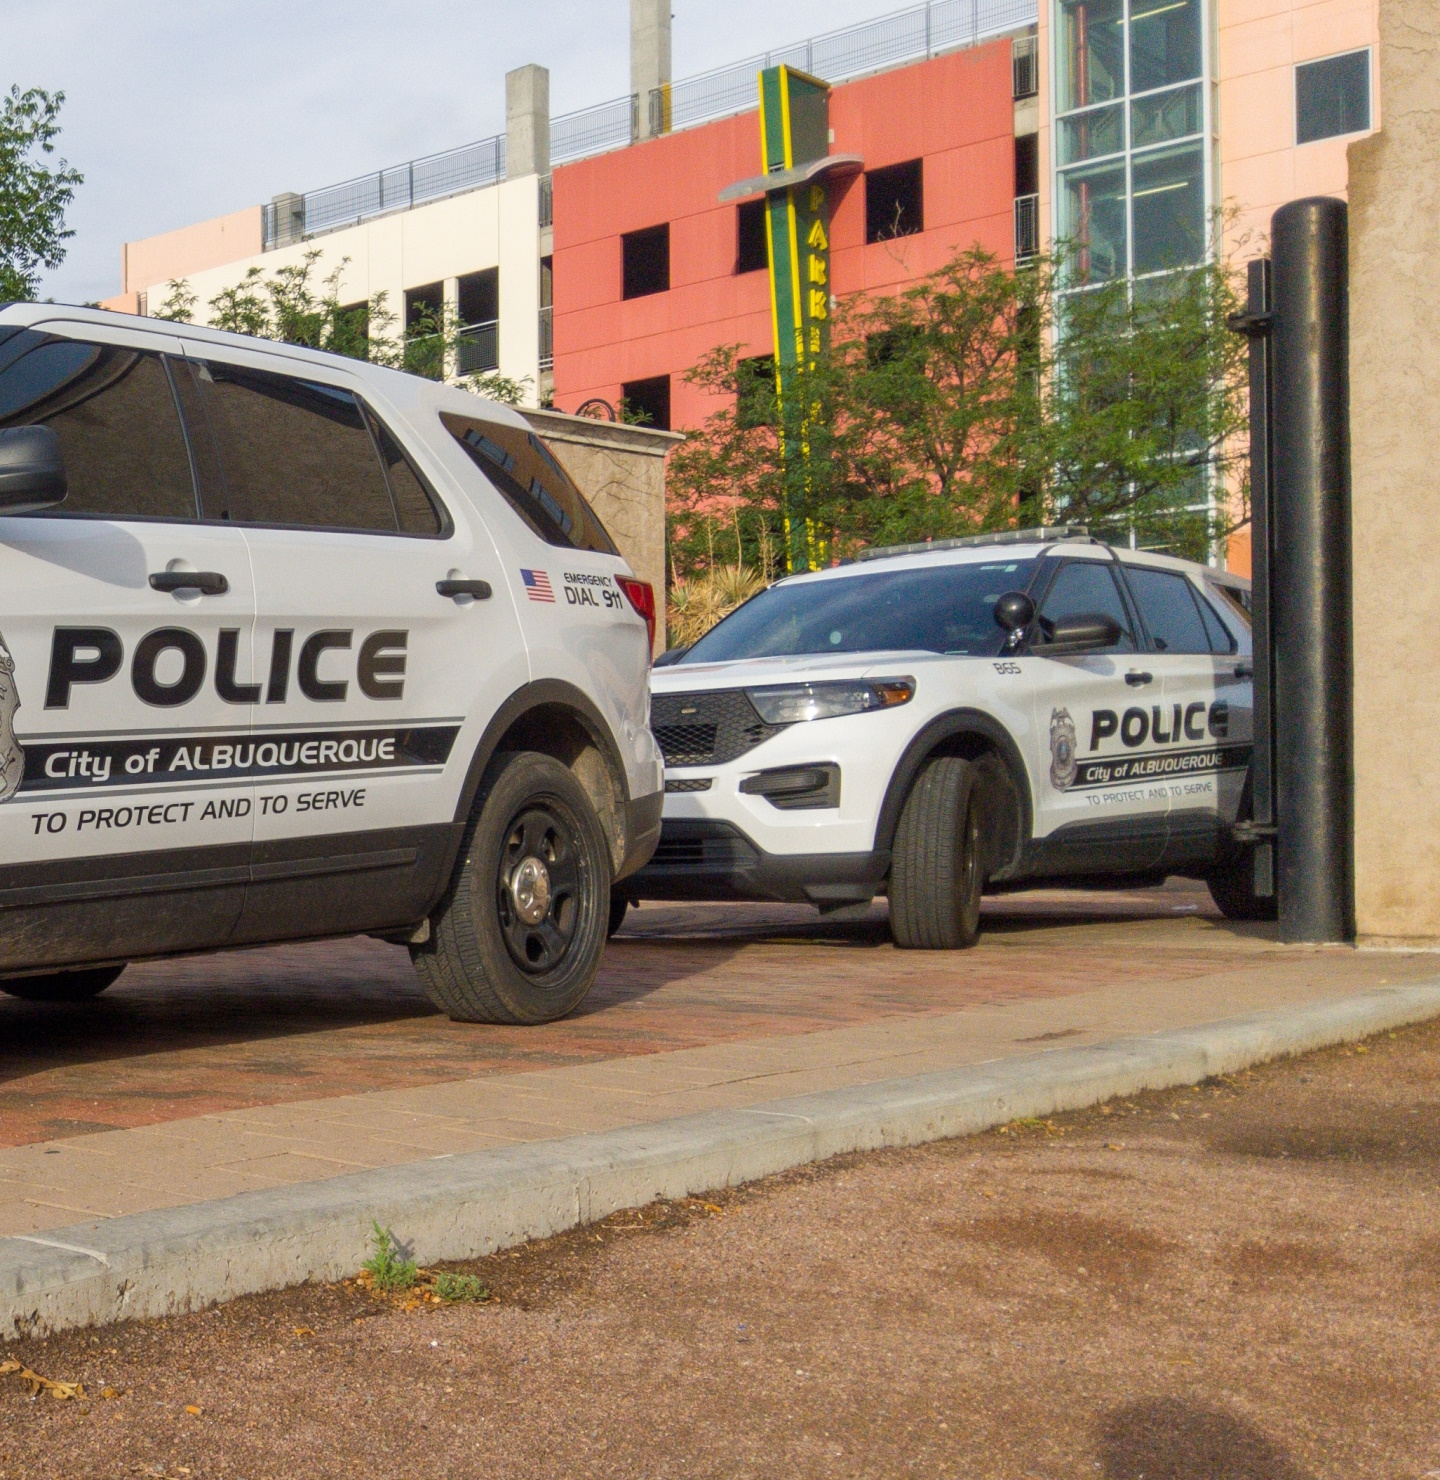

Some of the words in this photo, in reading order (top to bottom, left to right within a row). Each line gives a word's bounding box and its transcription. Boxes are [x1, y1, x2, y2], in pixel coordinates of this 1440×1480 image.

[564, 572, 612, 587] EMERGENCY
[564, 586, 600, 607] DIAL
[602, 590, 623, 609] 911
[43, 625, 409, 710] POLICE
[1090, 700, 1229, 751] POLICE
[44, 749, 111, 781] City
[125, 750, 160, 775] of
[168, 737, 395, 772] ALBUQUERQUE
[1086, 767, 1110, 781] City
[1114, 766, 1128, 778] of
[1130, 752, 1223, 775] ALBUQUERQUE
[31, 813, 67, 835] TO
[76, 802, 195, 831] PROTECT
[201, 797, 252, 820] AND
[259, 794, 289, 815] TO
[296, 788, 367, 812] SERVE
[1086, 795, 1101, 806] TO
[1103, 790, 1145, 804] PROTECT
[1148, 788, 1168, 799] AND
[1169, 786, 1182, 797] TO
[1185, 782, 1212, 795] SERVE
